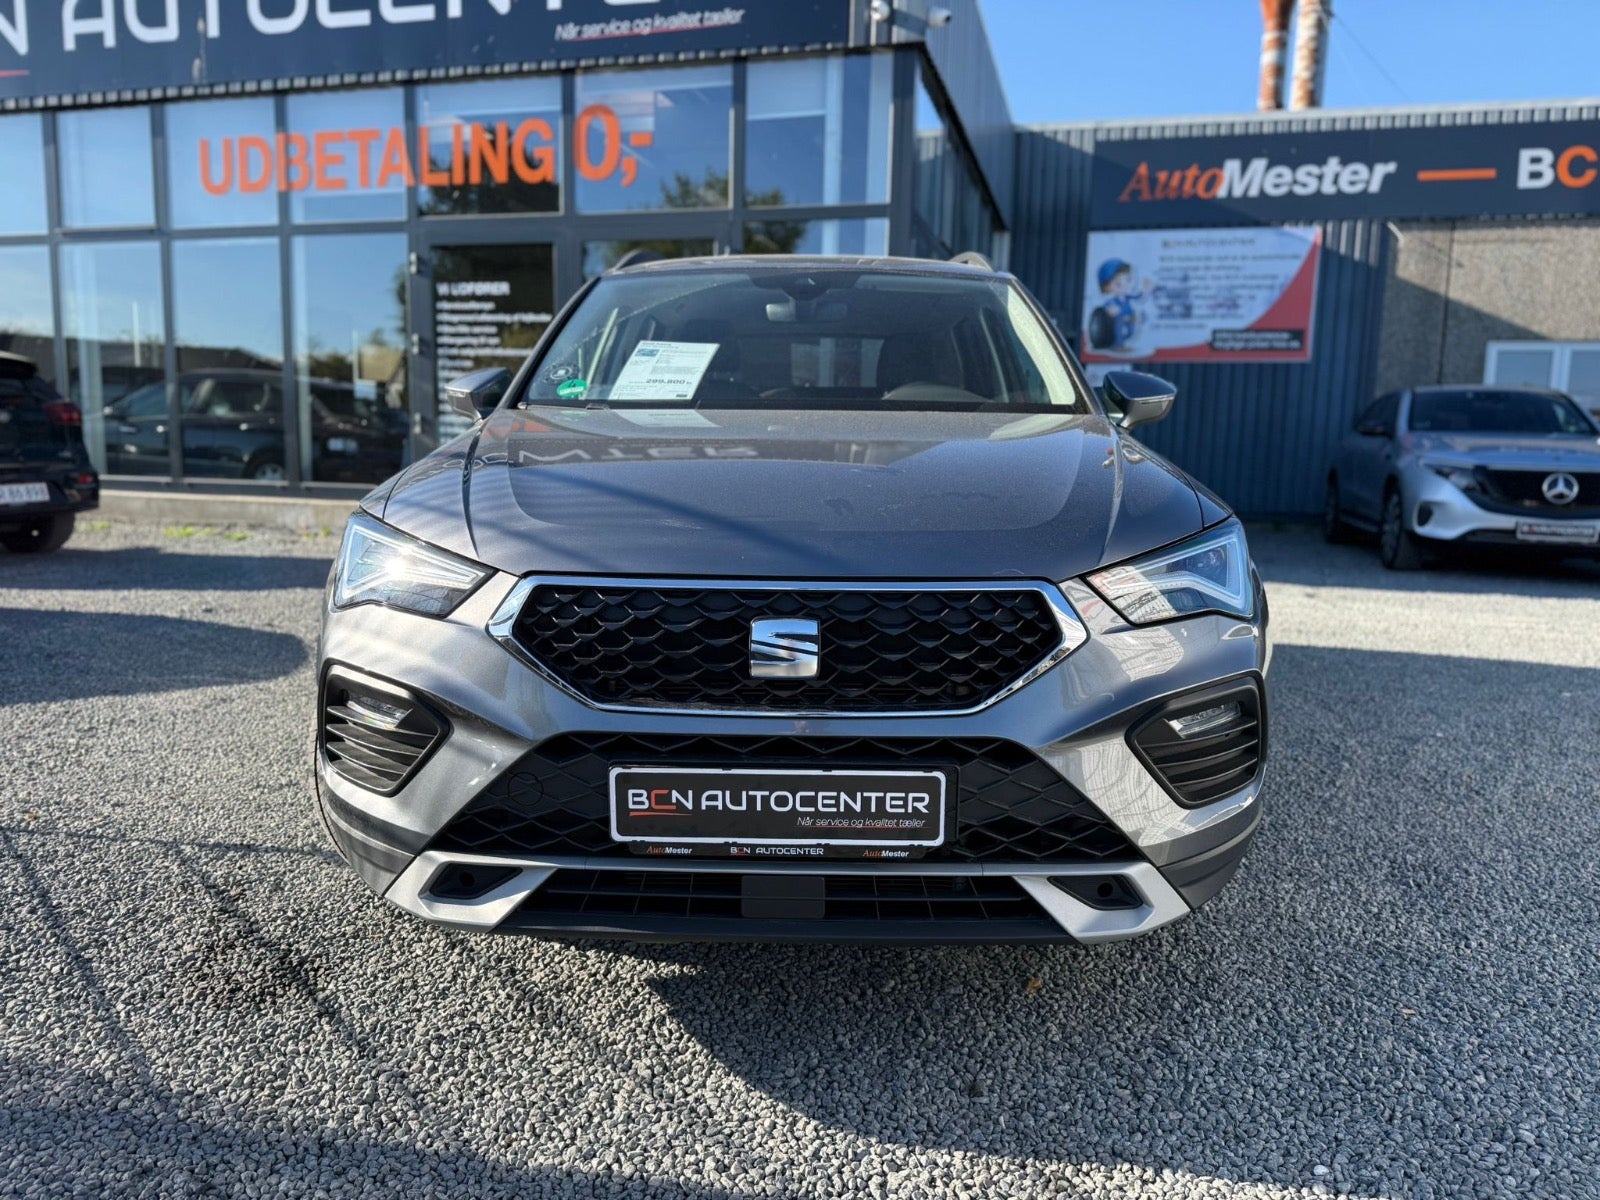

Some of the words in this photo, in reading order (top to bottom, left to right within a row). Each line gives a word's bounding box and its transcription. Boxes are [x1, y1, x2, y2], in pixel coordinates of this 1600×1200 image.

[581, 18, 631, 37] service
[199, 118, 556, 196] UDBETALING
[1516, 144, 1598, 190] BC
[1117, 156, 1398, 202] AutoMester
[627, 789, 693, 810] BCN
[700, 789, 930, 813] AUTOCENTER
[797, 816, 813, 826] Når
[815, 817, 849, 827] service
[850, 819, 863, 829] og
[865, 817, 897, 828] kvalitet
[899, 818, 926, 828] tæller
[730, 846, 751, 855] BCN
[755, 847, 824, 855] AUTOCENTER
